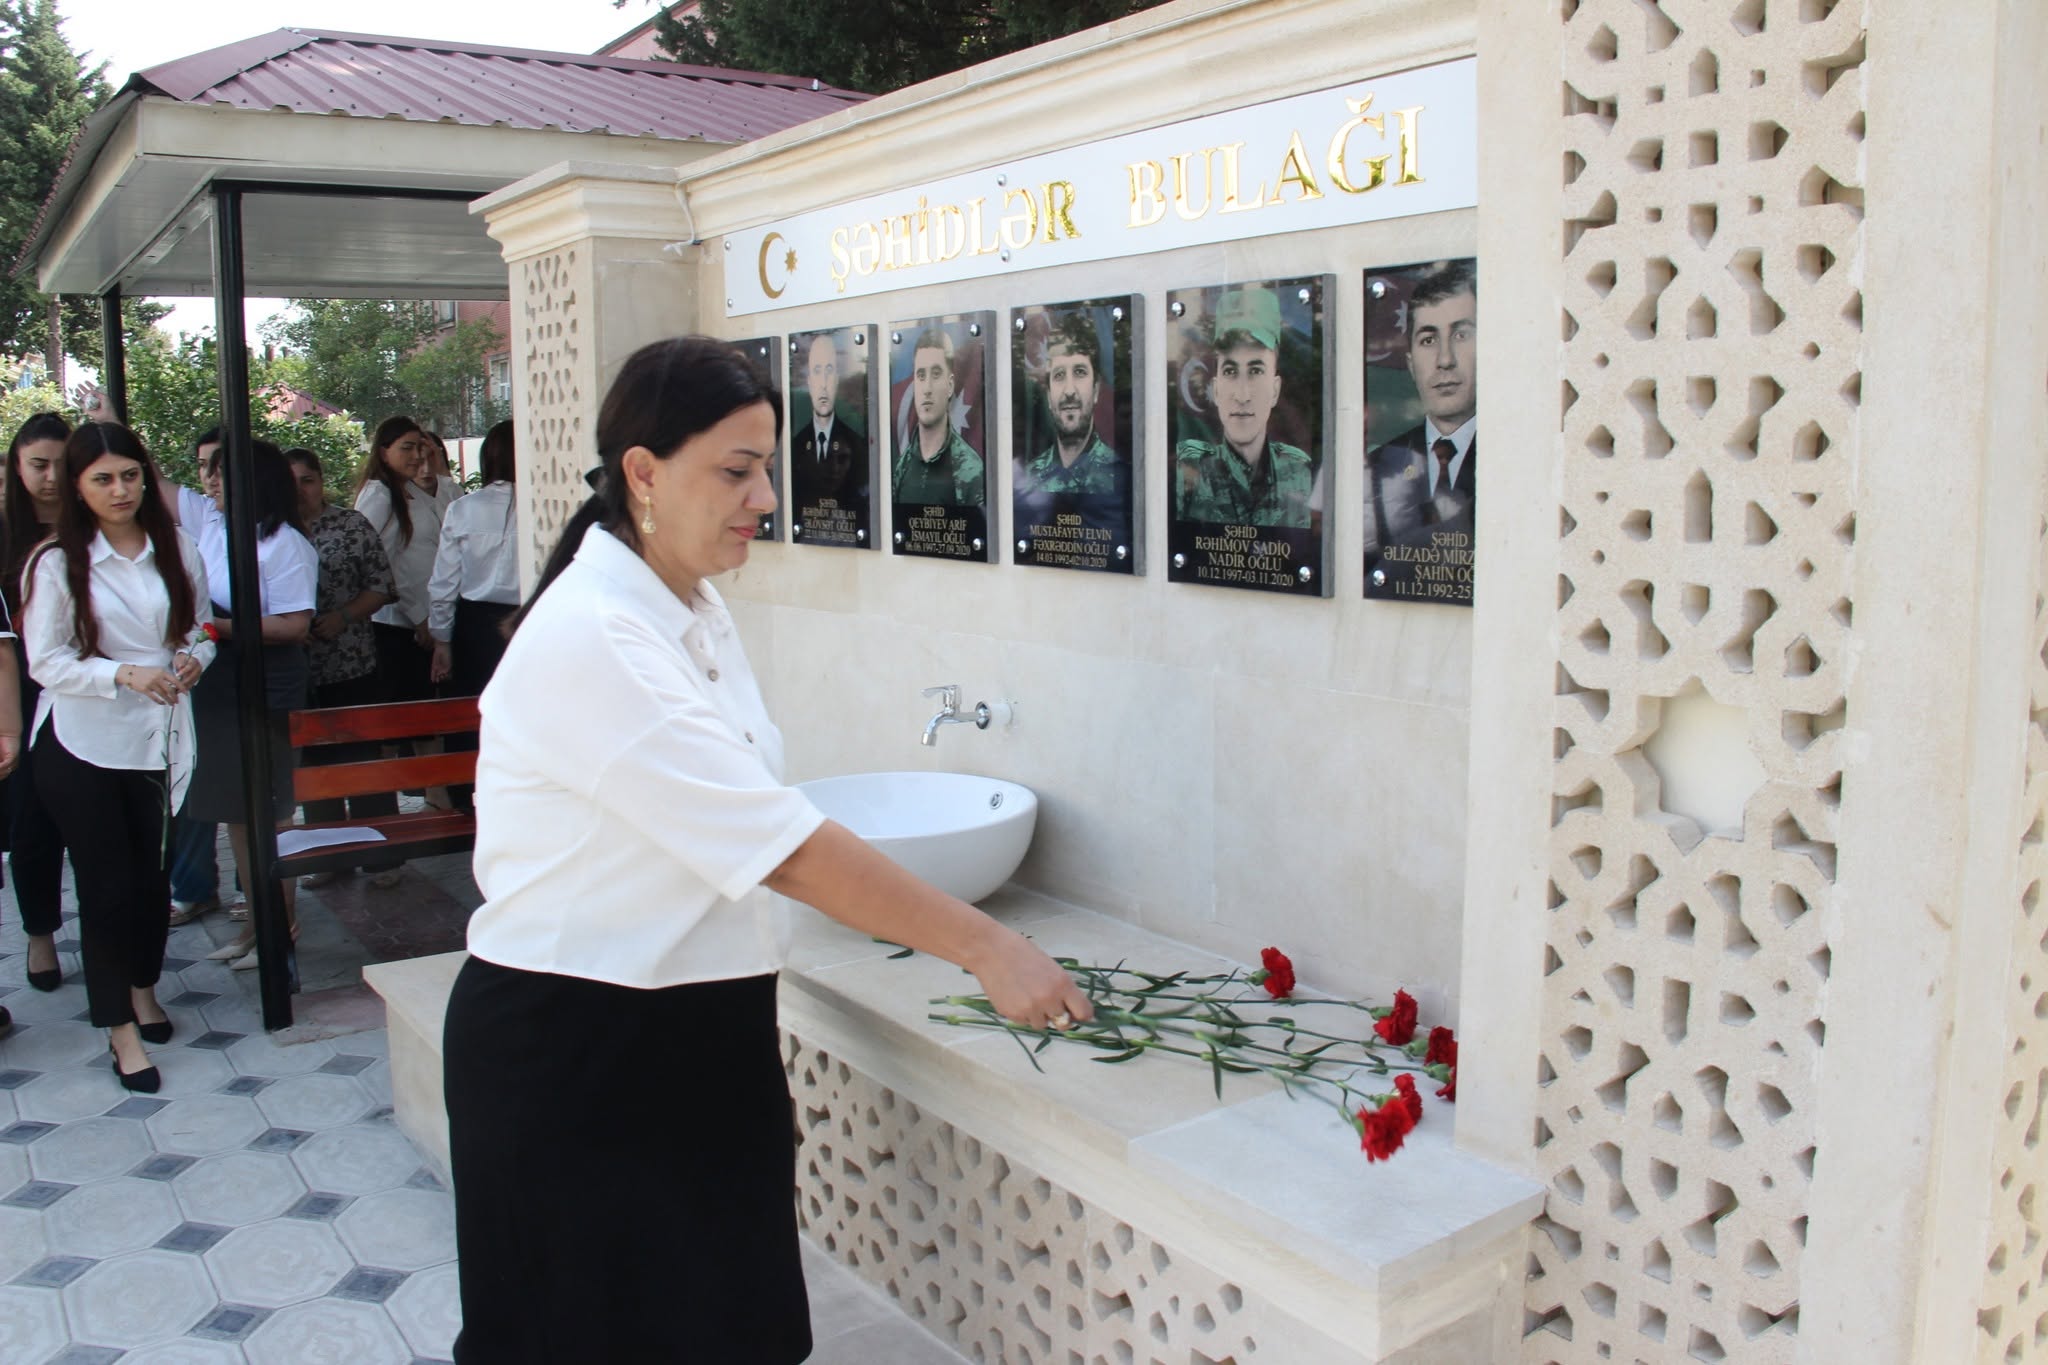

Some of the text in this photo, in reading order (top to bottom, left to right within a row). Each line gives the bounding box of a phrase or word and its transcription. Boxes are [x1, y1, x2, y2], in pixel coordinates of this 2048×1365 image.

[830, 92, 1426, 294] ŞƏHİDLƏR BULAĞI
[923, 505, 945, 517] ŞƏHİD
[1057, 513, 1082, 525] ŞƏHİD
[943, 530, 966, 545] OĞLU
[1030, 525, 1112, 541] MUSTAFAYEV ELVİN
[1224, 524, 1258, 539] ŞƏHİD
[1431, 531, 1469, 549] ŞƏHİD
[1033, 539, 1110, 556] FƏXRƏDDİN OĞLU
[1195, 535, 1291, 559] RƏHİMOV SADİQ
[1383, 544, 1475, 566] ƏLİZADƏ MİRZ
[1208, 552, 1283, 571] NADİR OĞLU
[1197, 566, 1295, 587] 10.12.1997-03.11.2020
[1395, 581, 1474, 599] 11.12.1992-25.
